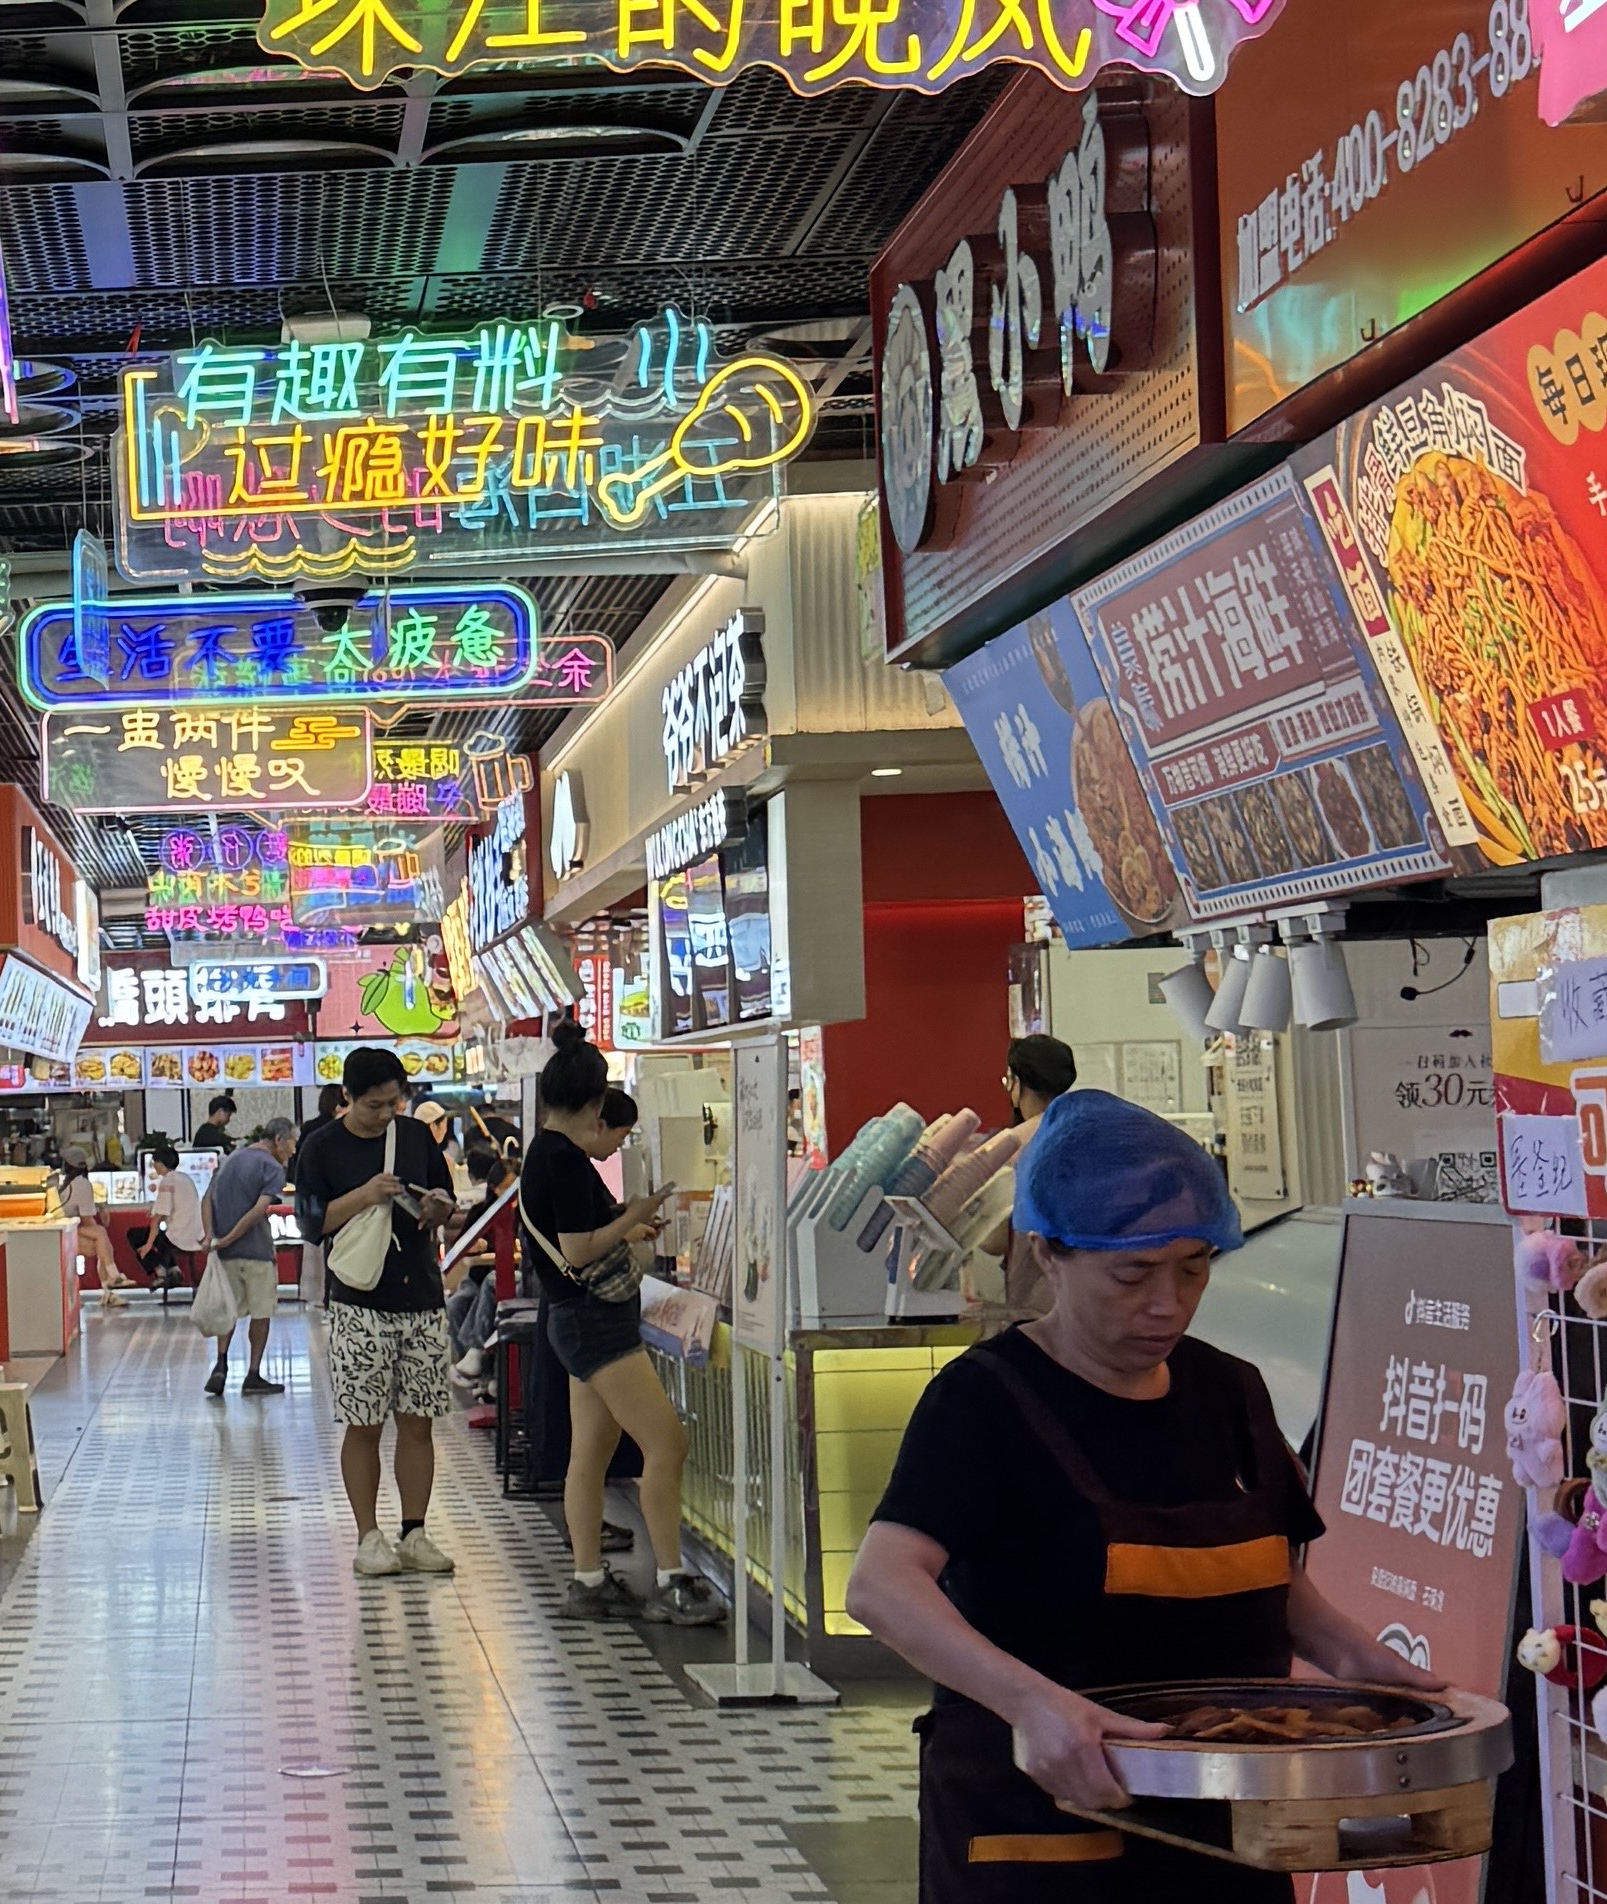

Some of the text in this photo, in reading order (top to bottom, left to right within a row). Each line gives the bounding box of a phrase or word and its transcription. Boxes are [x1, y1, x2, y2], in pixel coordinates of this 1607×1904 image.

[178, 322, 564, 429] 有趣有料
[224, 406, 604, 505] 过瘾好味
[56, 603, 506, 684] 生活不要太疲惫
[1130, 542, 1304, 719] 捞汁海鲜
[63, 707, 276, 753] 一盅两件
[1540, 697, 1589, 739] 1人餐
[160, 754, 320, 801] 慢慢叹
[144, 904, 294, 934] 甜皮烤鸭吃
[1394, 1072, 1494, 1110] 领30元
[1379, 1354, 1487, 1455] 抖音扫码
[1338, 1437, 1504, 1559] 团套餐更优惠
